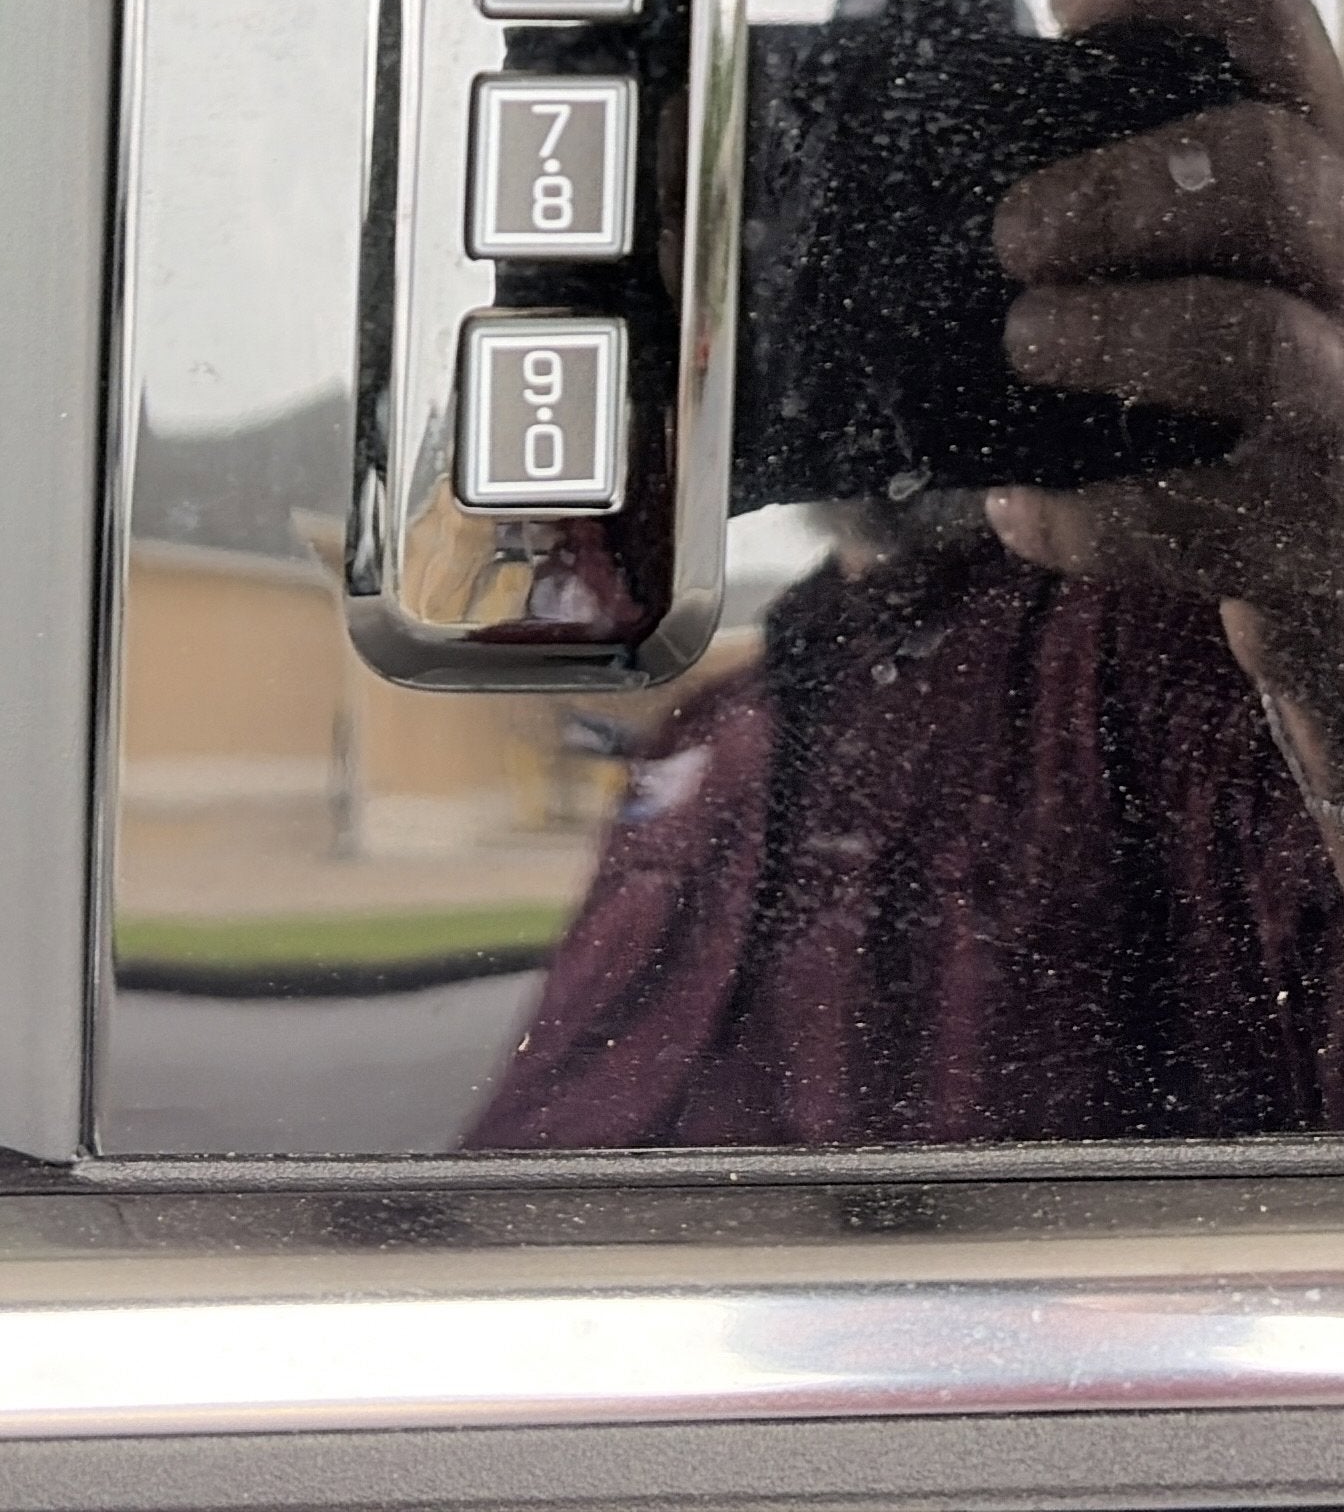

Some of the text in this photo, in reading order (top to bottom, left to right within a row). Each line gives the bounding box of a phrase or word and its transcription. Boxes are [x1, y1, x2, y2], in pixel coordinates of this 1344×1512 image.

[531, 104, 572, 158] 7
[532, 176, 573, 230] 8
[523, 350, 563, 405] 9
[524, 424, 565, 478] 0
